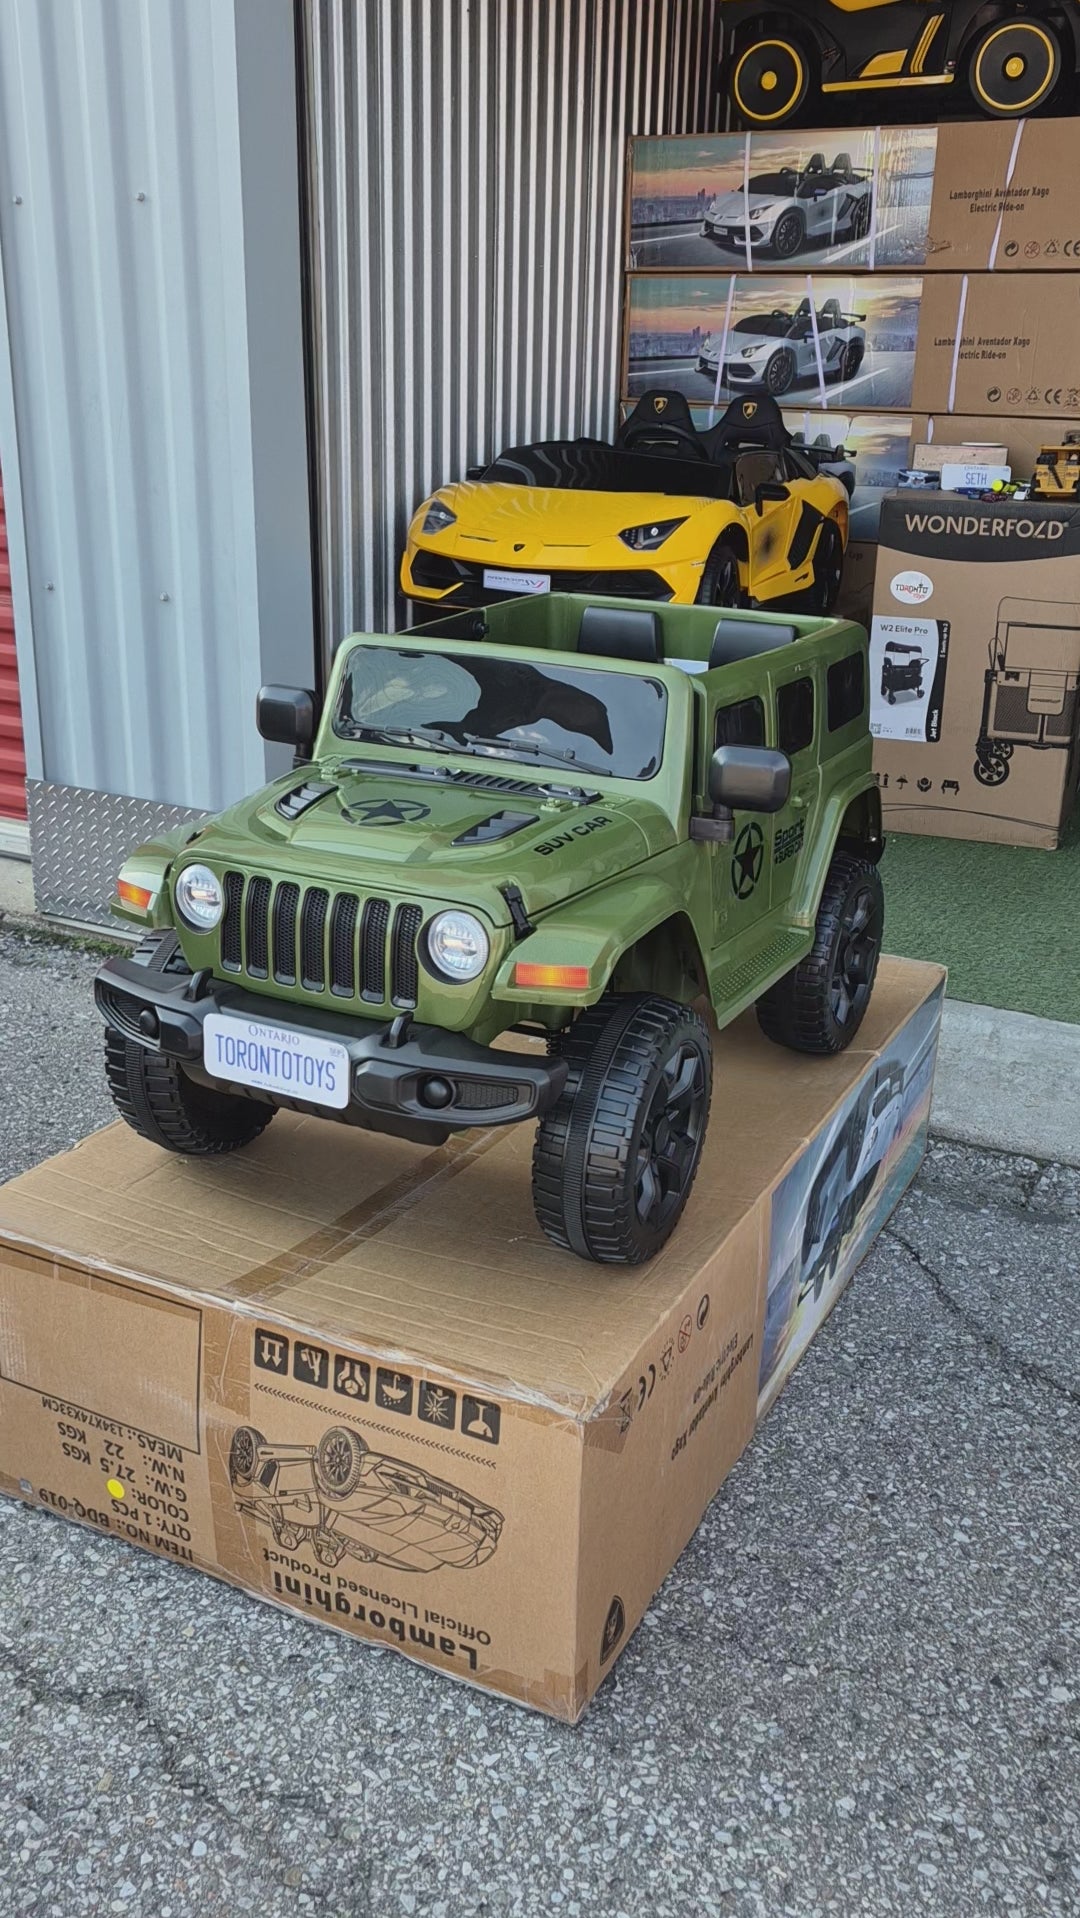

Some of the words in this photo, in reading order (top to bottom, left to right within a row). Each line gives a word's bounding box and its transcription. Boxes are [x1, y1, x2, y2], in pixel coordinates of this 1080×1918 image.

[950, 188, 992, 200] Lamborghini
[1032, 186, 1050, 198] Xago
[970, 202, 997, 213] Electric
[934, 337, 975, 348] Lamboghini
[977, 336, 1011, 346] Aventador
[1013, 336, 1030, 347] Xago
[958, 350, 980, 359] lectric
[981, 350, 1006, 360] Ride-on
[965, 472, 987, 486] SETH
[904, 513, 1064, 540] WONDERFOLD
[896, 583, 928, 594] TORONTO
[880, 624, 893, 632] W2
[895, 625, 912, 634] Elite
[914, 626, 928, 635] Pro
[931, 709, 939, 726] Black
[534, 832, 574, 856] SUV
[572, 816, 613, 836] CAR
[775, 817, 805, 847] Sport
[248, 1024, 300, 1046] ONTARIO
[215, 1034, 336, 1092] TORONTOTOYS
[41, 1396, 123, 1437] 134X74X33CM
[57, 1422, 87, 1444] KGS
[61, 1442, 91, 1465] KGS
[103, 1440, 124, 1460] 22
[127, 1430, 183, 1463] MEAS.:
[100, 1458, 136, 1483] 27.5
[143, 1455, 185, 1483] N.W.:
[145, 1475, 187, 1502] G.W.:
[39, 1488, 110, 1528] BDQ-019
[111, 1500, 138, 1520] PCS
[131, 1488, 189, 1522] COLOR:
[143, 1512, 152, 1526] 1
[156, 1517, 191, 1541] QTY:
[116, 1520, 150, 1543] NO.:
[154, 1536, 193, 1561] ITEM
[262, 1548, 331, 1586] Product
[337, 1576, 418, 1619] Licensed
[274, 1571, 477, 1670] Lamborghini
[424, 1610, 491, 1645] Official
